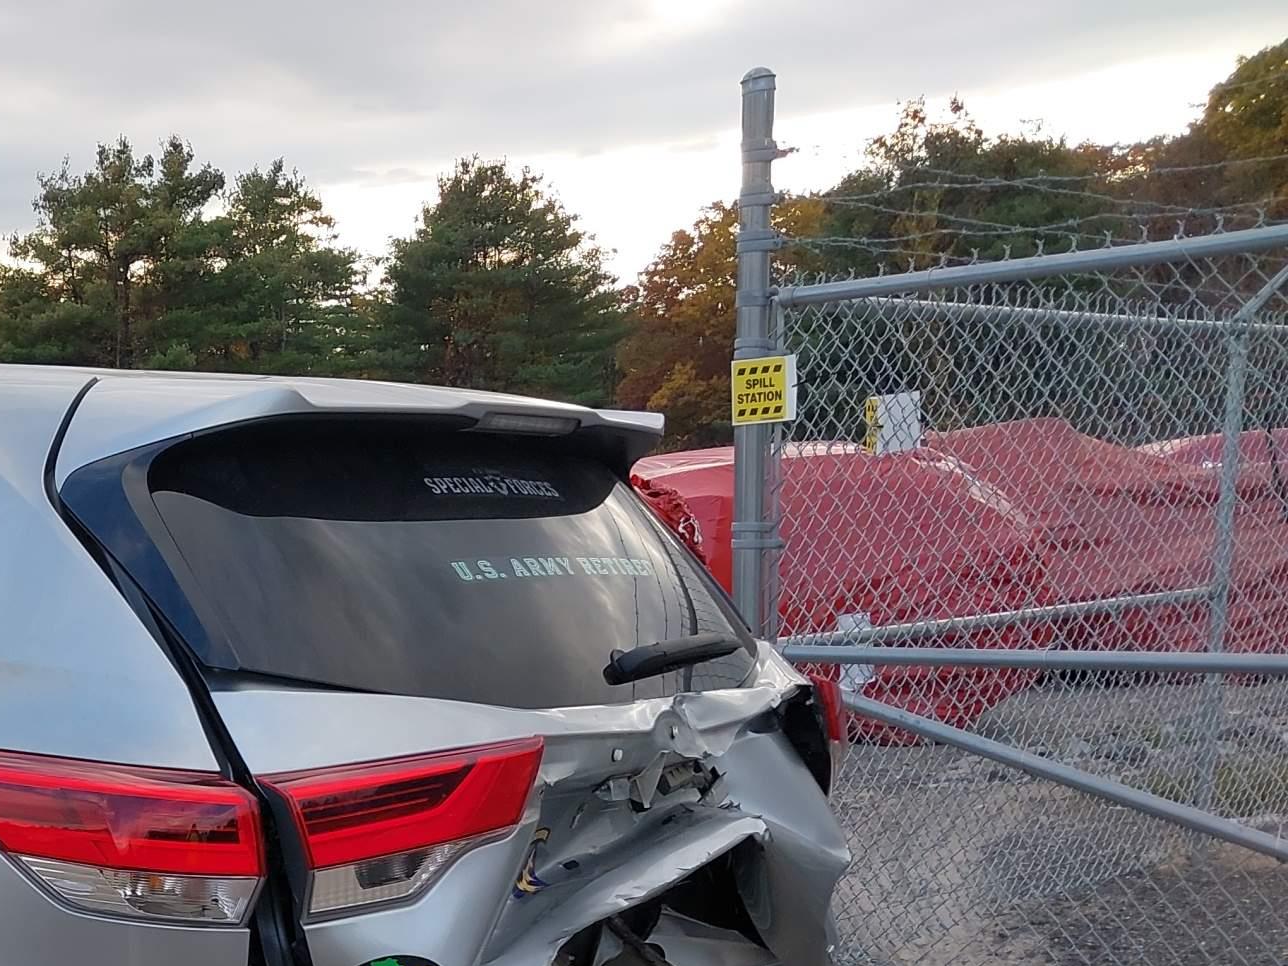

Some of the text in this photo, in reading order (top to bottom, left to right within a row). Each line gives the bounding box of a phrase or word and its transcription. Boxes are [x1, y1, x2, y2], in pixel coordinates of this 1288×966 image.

[745, 377, 775, 390] SPILL
[737, 390, 782, 405] STATION
[423, 476, 560, 498] SPECIAL FORCES
[451, 559, 507, 581] U.S.
[510, 557, 576, 577] ARMY
